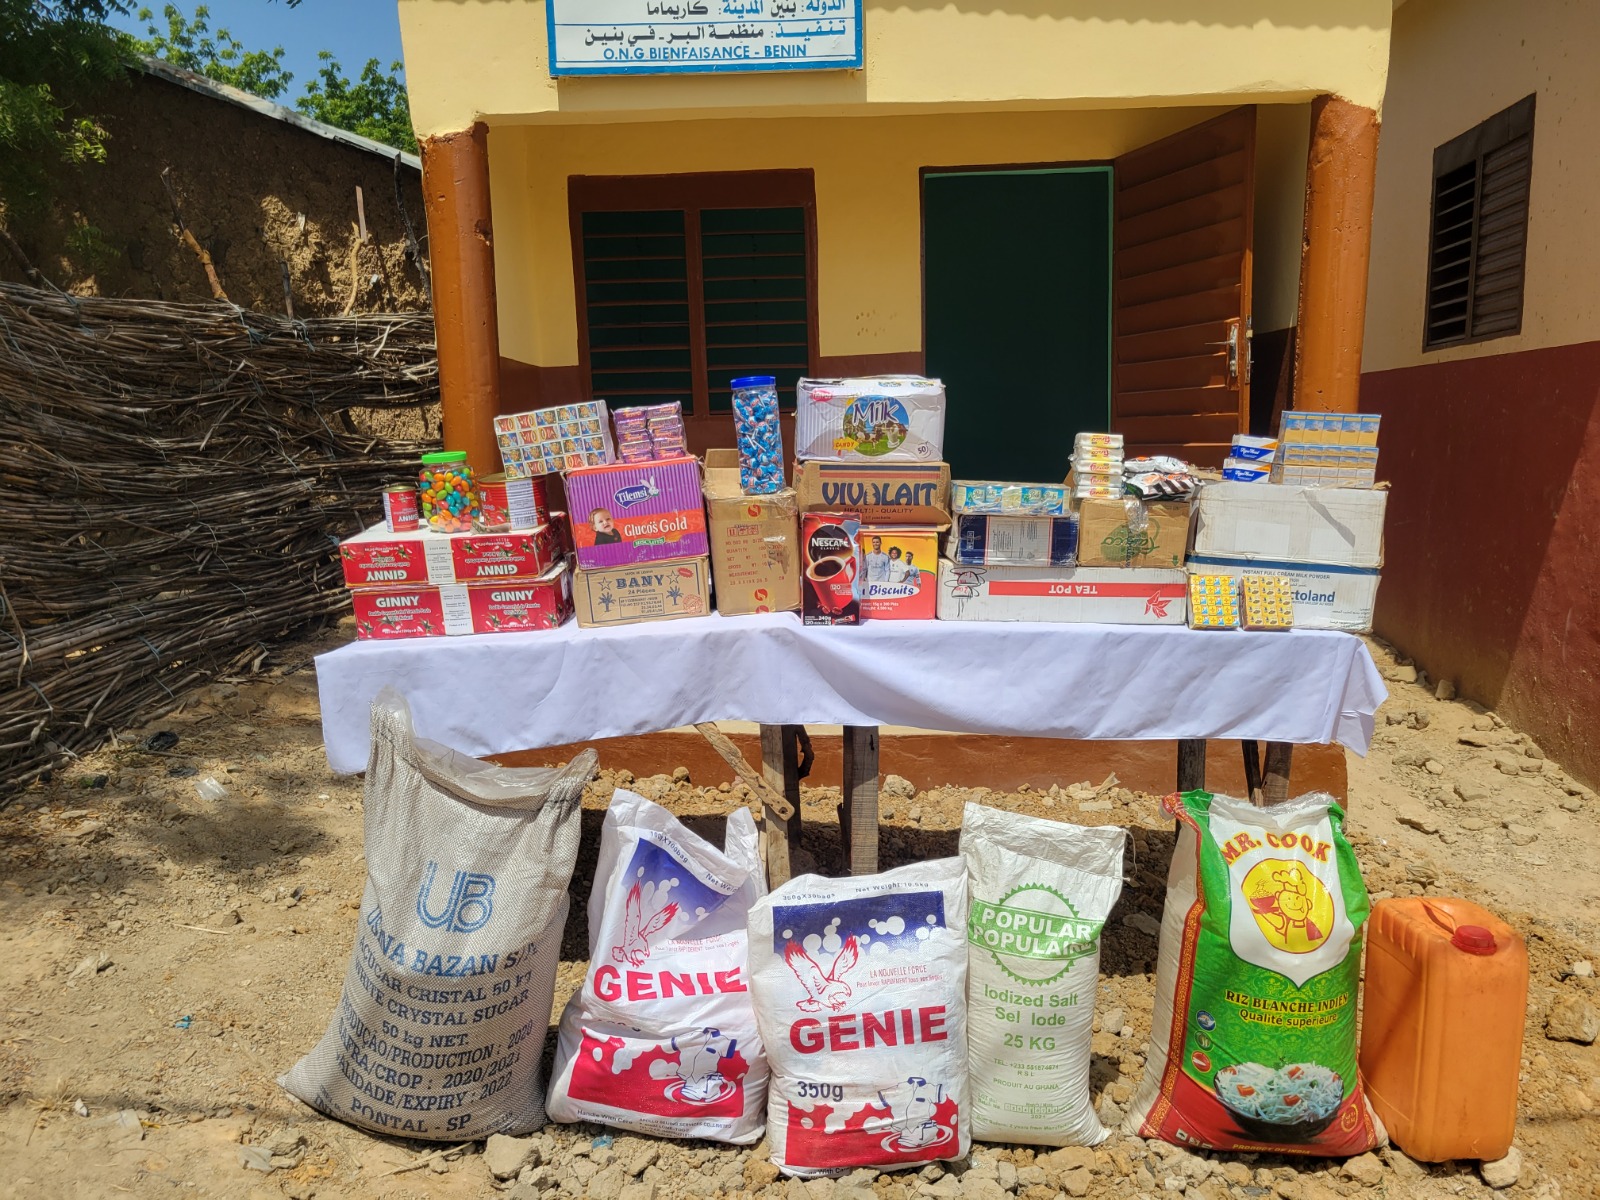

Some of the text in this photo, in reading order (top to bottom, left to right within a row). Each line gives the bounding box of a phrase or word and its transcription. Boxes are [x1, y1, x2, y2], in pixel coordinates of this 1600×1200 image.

[584, 27, 624, 46] بنين
[627, 25, 656, 46] في
[667, 26, 704, 45] البر
[709, 23, 764, 40] منظمة
[650, 45, 750, 60] BIENFAISANCE
[765, 44, 807, 58] BENIN
[853, 399, 900, 426] Milk
[917, 446, 927, 455] 50
[616, 487, 648, 504] Tilemsi
[659, 517, 688, 533] Gold
[366, 569, 408, 581] GINNY
[476, 564, 518, 576] GINNY
[615, 574, 665, 590] BANY
[868, 584, 914, 596] Biscuits
[1048, 584, 1098, 595] TEA POT
[375, 595, 420, 608] GINNY
[491, 590, 534, 602] GINNY
[1220, 832, 1331, 866] MR. COOK
[705, 873, 718, 885] Net
[981, 907, 1092, 941] POPULAR
[411, 949, 500, 978] BAZAN
[594, 964, 748, 1003] GENIE
[869, 970, 878, 978] LA
[407, 985, 488, 1004] CRISTAL
[492, 979, 511, 997] 50
[984, 984, 1079, 1008] Iodized Salt
[388, 999, 468, 1025] CRYSTAL
[473, 989, 530, 1023] SUGAR
[1226, 990, 1349, 1013] RIZ BLANCHE INDIEN
[995, 1006, 1066, 1026] Sel Iode
[1239, 1009, 1338, 1028] Qualité supérieure
[382, 1020, 399, 1038] 50
[404, 1031, 424, 1049] kg
[789, 1004, 948, 1055] GENIE
[1004, 1032, 1056, 1051] 25 KG
[442, 1052, 521, 1090] 2020/2021
[480, 1070, 513, 1101] 2022
[797, 1080, 844, 1102] 350g
[993, 1077, 1022, 1089] PRODUIT
[1035, 1083, 1060, 1091] GHANA
[351, 1098, 428, 1133] PONTAL
[446, 1113, 472, 1132] SP
[1232, 1143, 1273, 1152] PRODUCT
